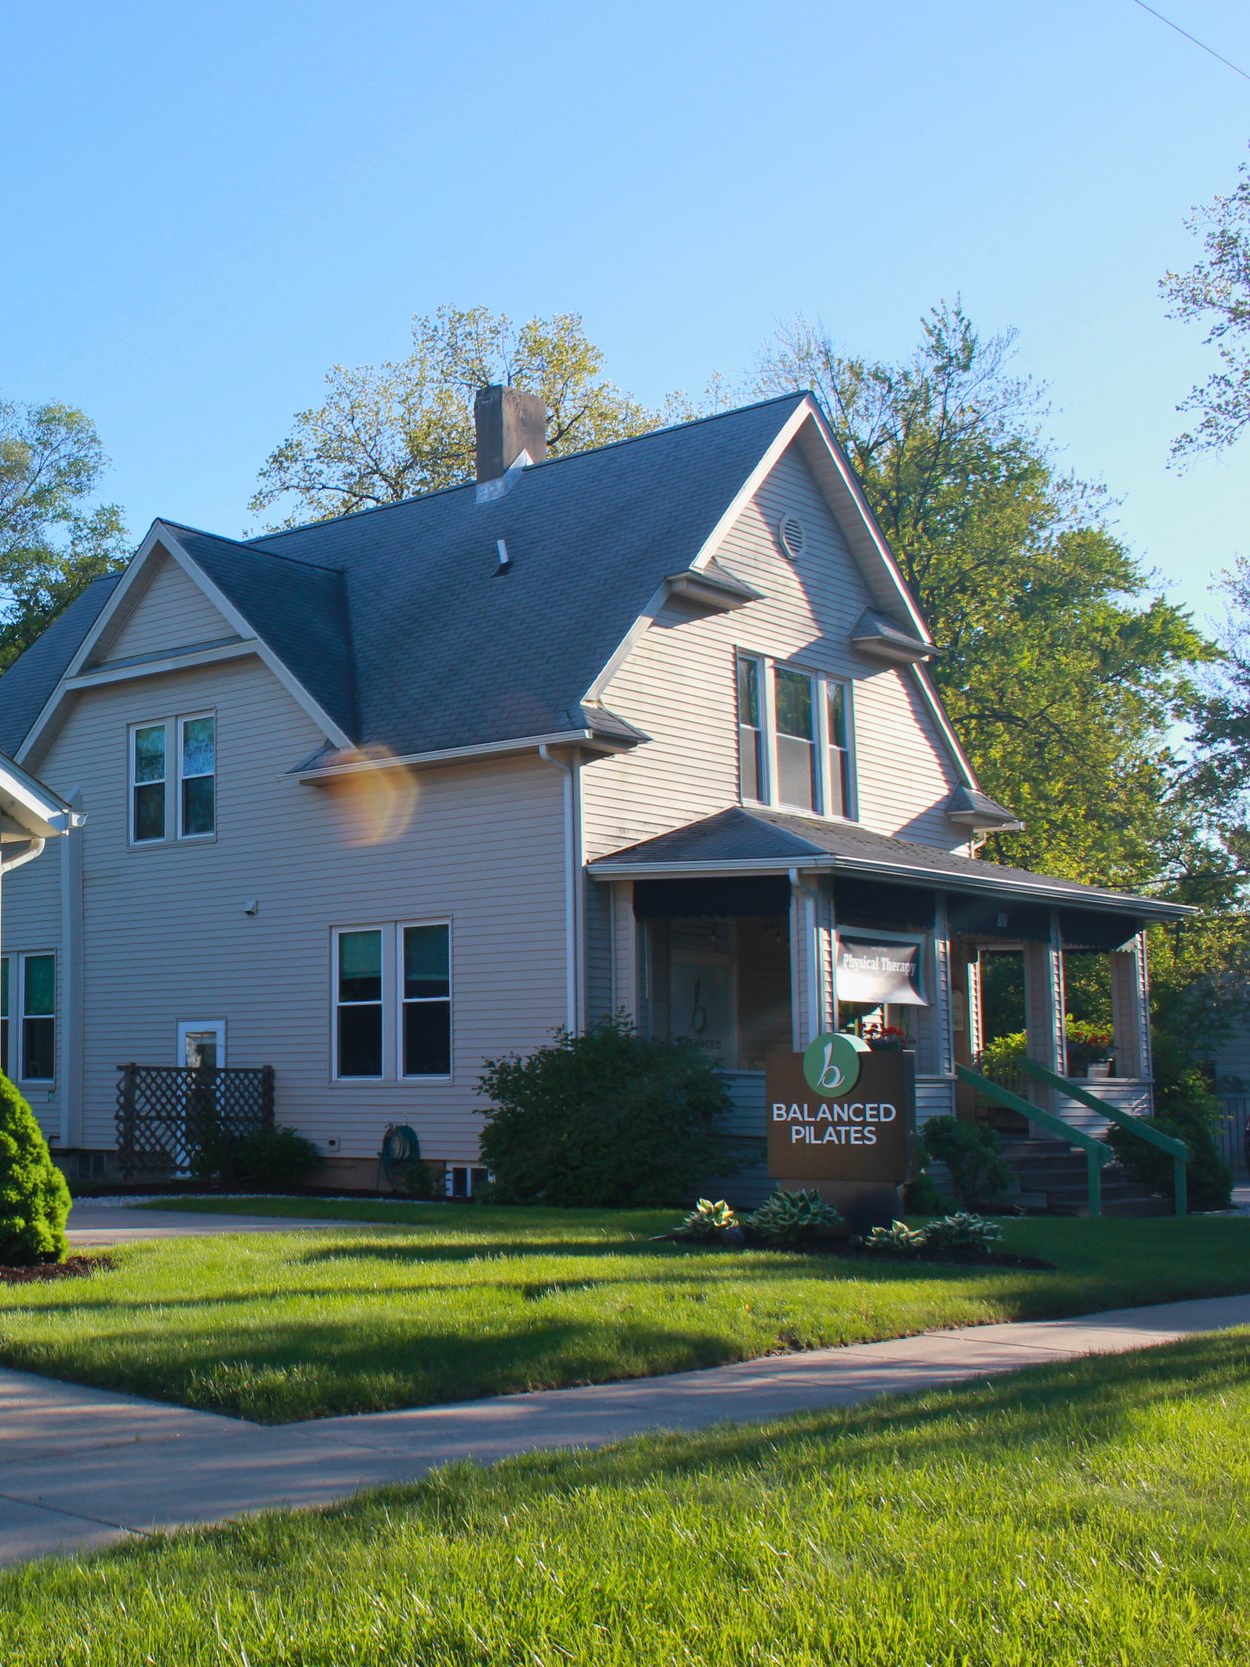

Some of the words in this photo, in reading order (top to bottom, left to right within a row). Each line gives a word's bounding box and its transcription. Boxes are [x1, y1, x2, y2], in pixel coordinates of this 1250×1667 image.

[843, 953, 879, 971] Physical
[881, 957, 916, 976] Therapy
[773, 1103, 896, 1122] BALANCED
[791, 1126, 877, 1145] PILATES
